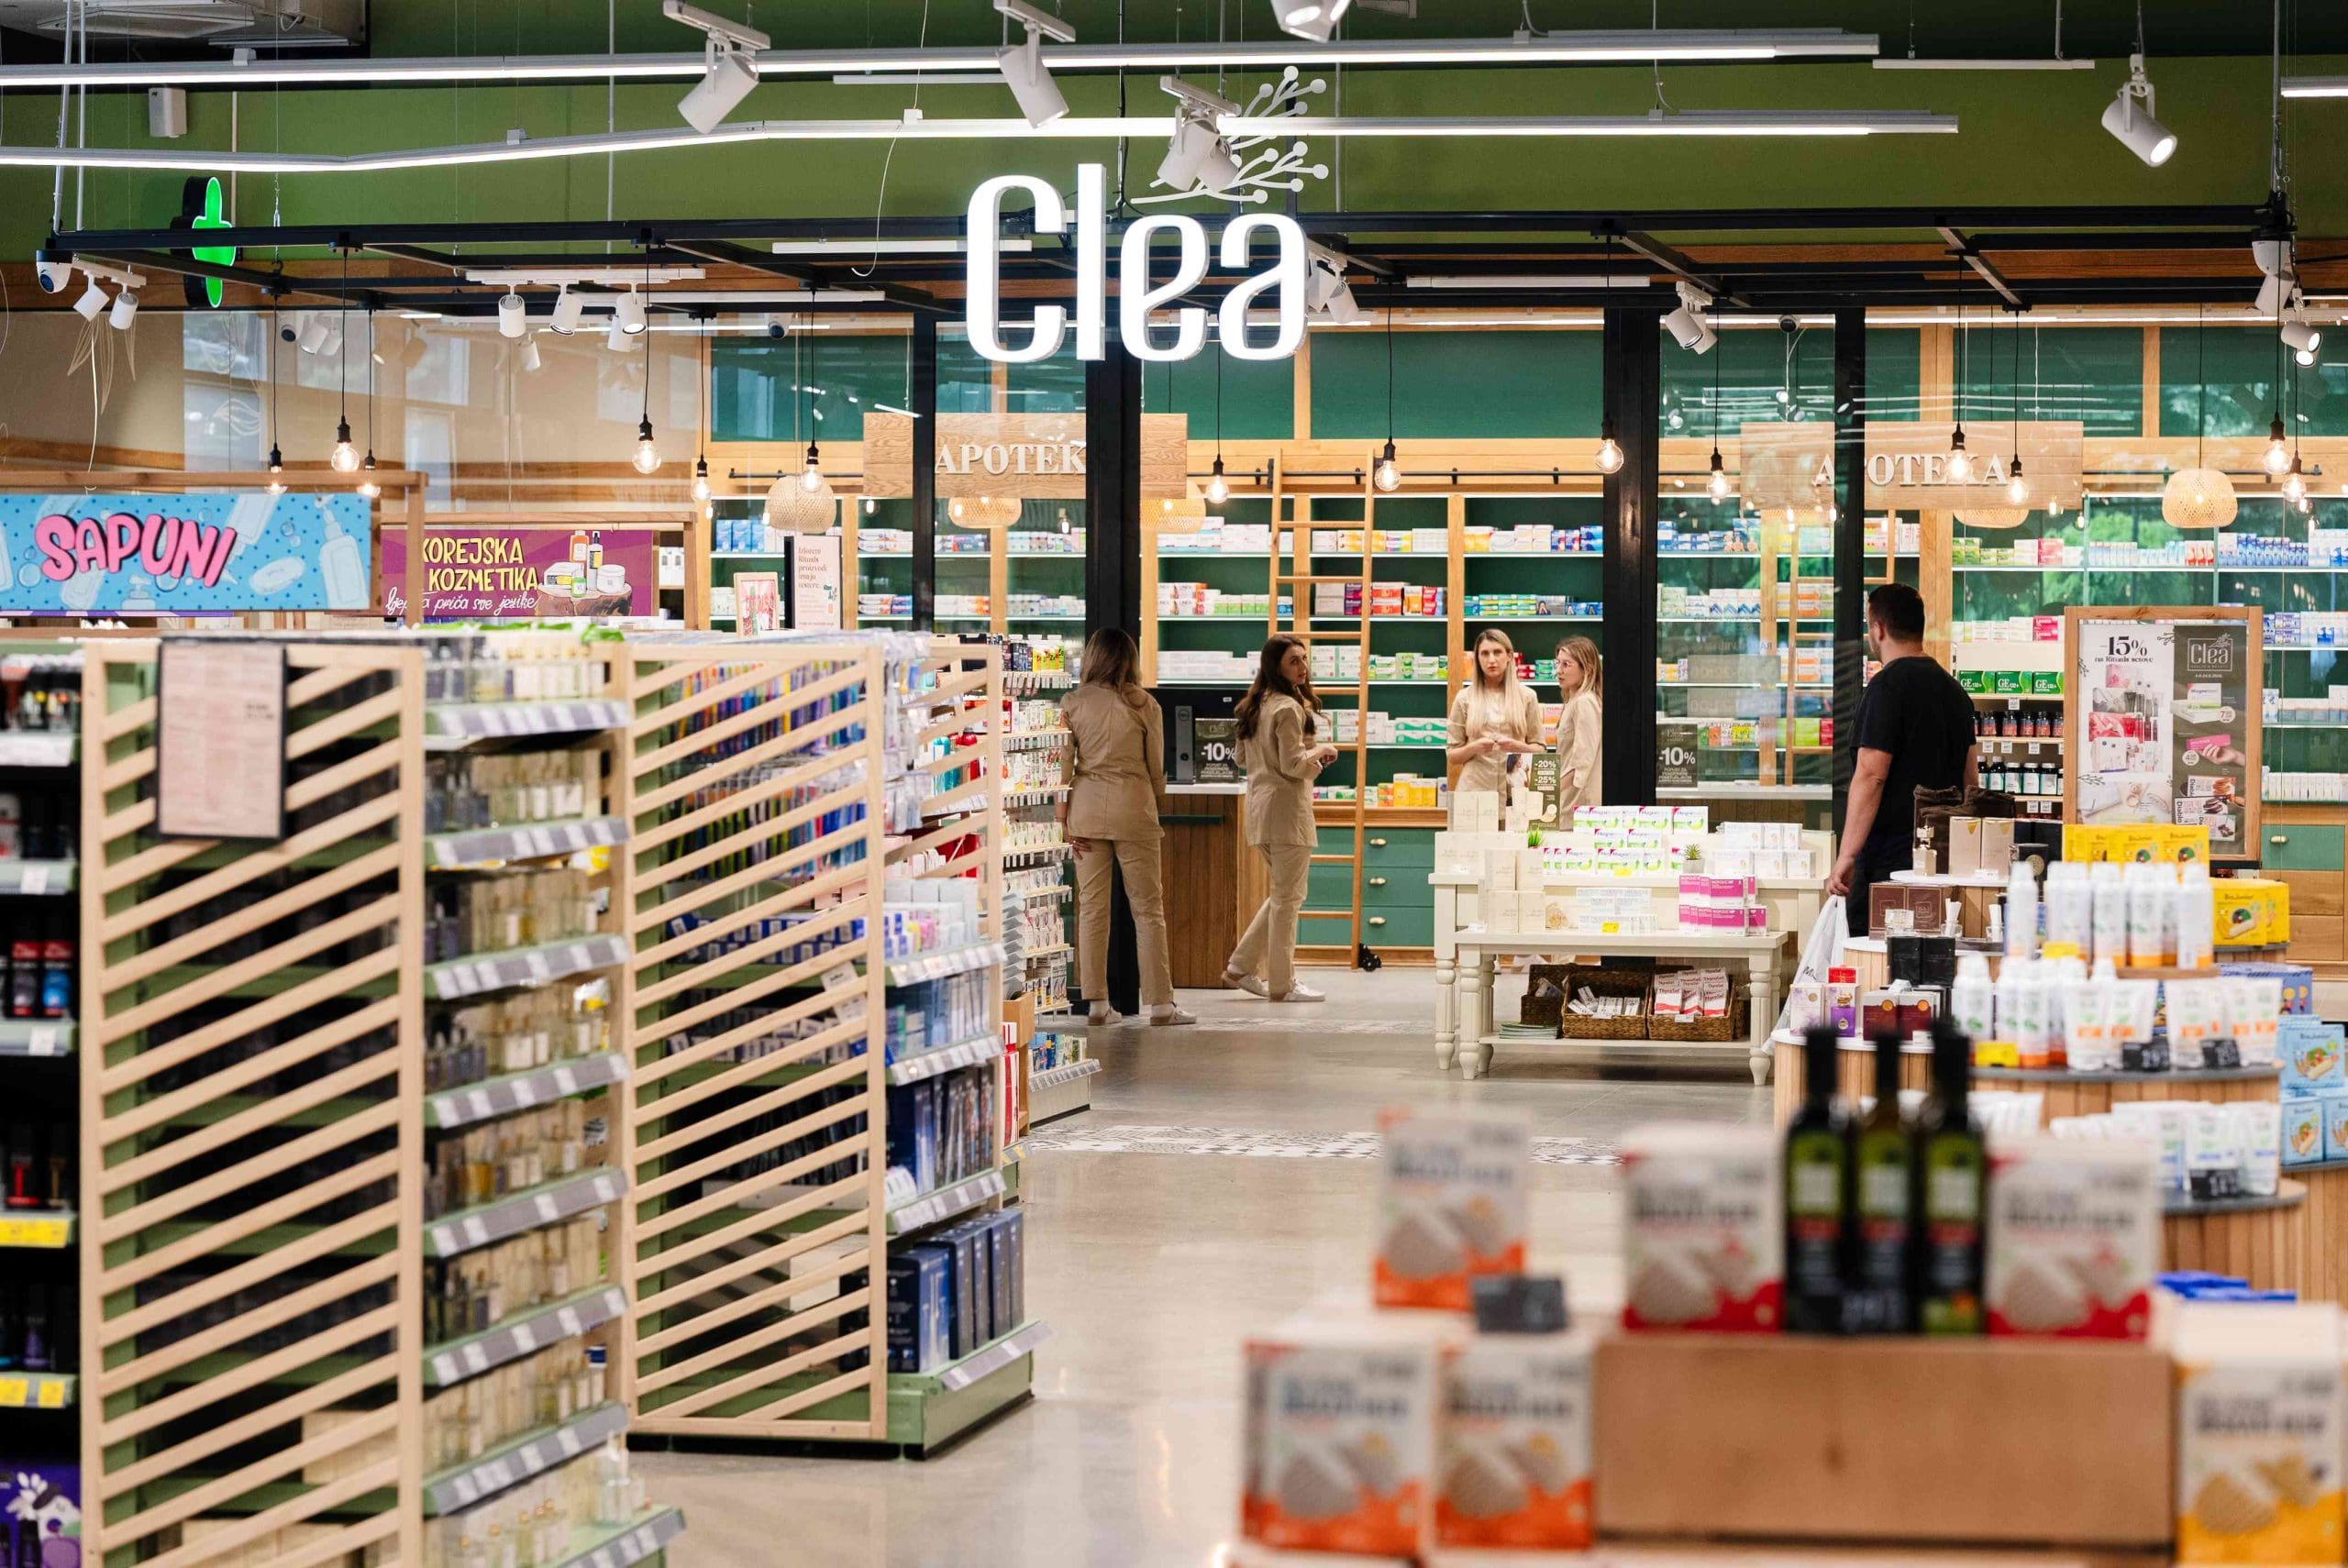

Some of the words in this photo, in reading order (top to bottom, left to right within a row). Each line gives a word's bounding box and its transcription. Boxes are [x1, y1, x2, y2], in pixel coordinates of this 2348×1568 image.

[967, 163, 1310, 362] Clea
[935, 444, 1086, 474] APOTEK
[36, 513, 238, 588] SAPUNI
[428, 568, 539, 591] KOZMETIKA
[434, 594, 468, 615] priča
[2100, 635, 2147, 656] -15%
[2190, 644, 2229, 666] Clea
[1201, 743, 1235, 761] -10%
[1658, 746, 1696, 766] -10%
[1534, 760, 1556, 768] -20%
[1534, 776, 1556, 784] -25%
